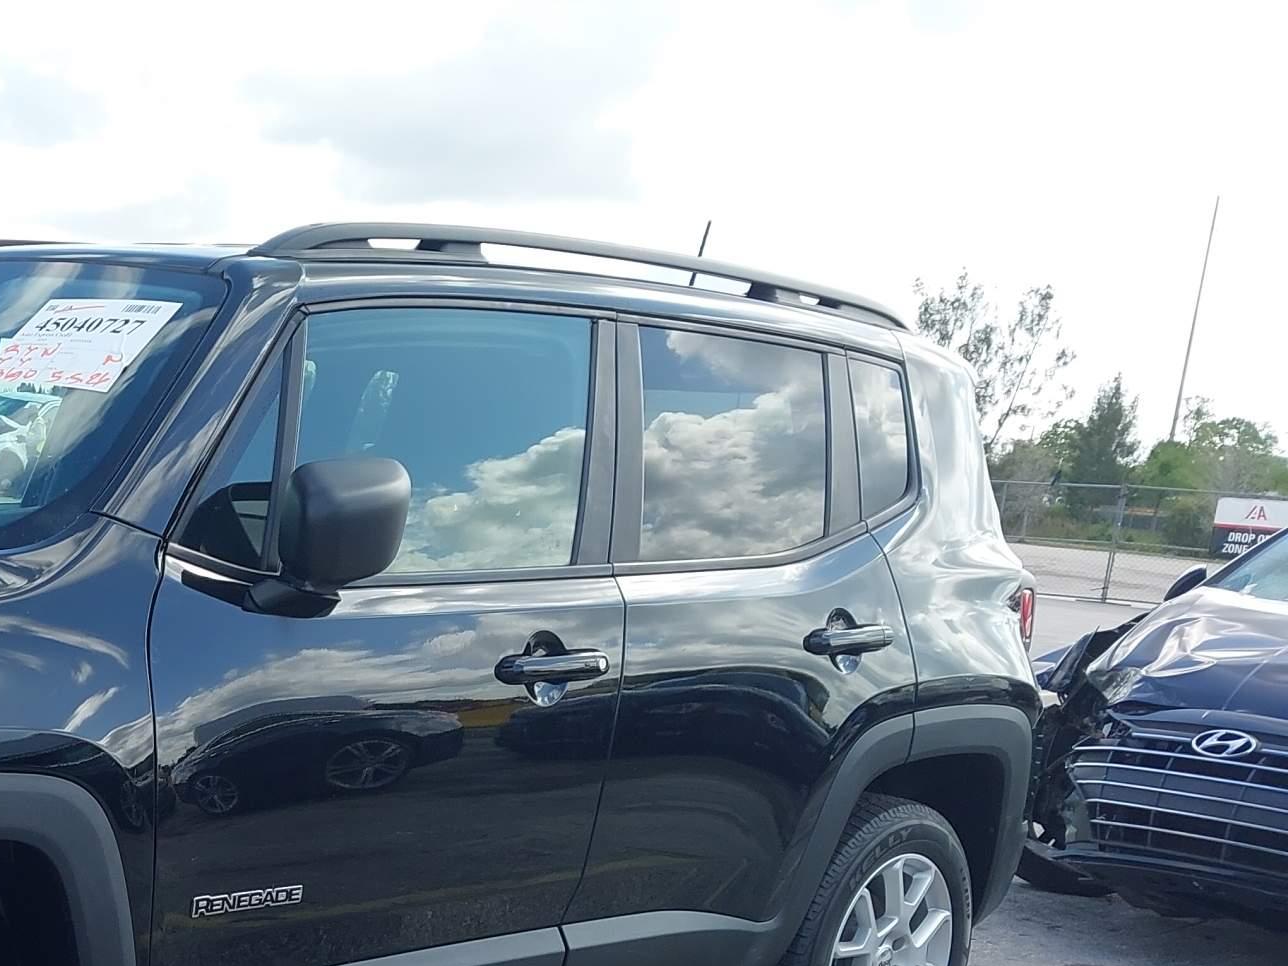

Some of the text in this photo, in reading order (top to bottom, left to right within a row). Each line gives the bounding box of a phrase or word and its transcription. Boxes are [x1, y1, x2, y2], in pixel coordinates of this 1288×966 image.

[35, 317, 148, 335] 45040727
[1227, 531, 1256, 543] DROP
[1221, 543, 1249, 554] ZONE
[192, 885, 304, 919] RENEGADE
